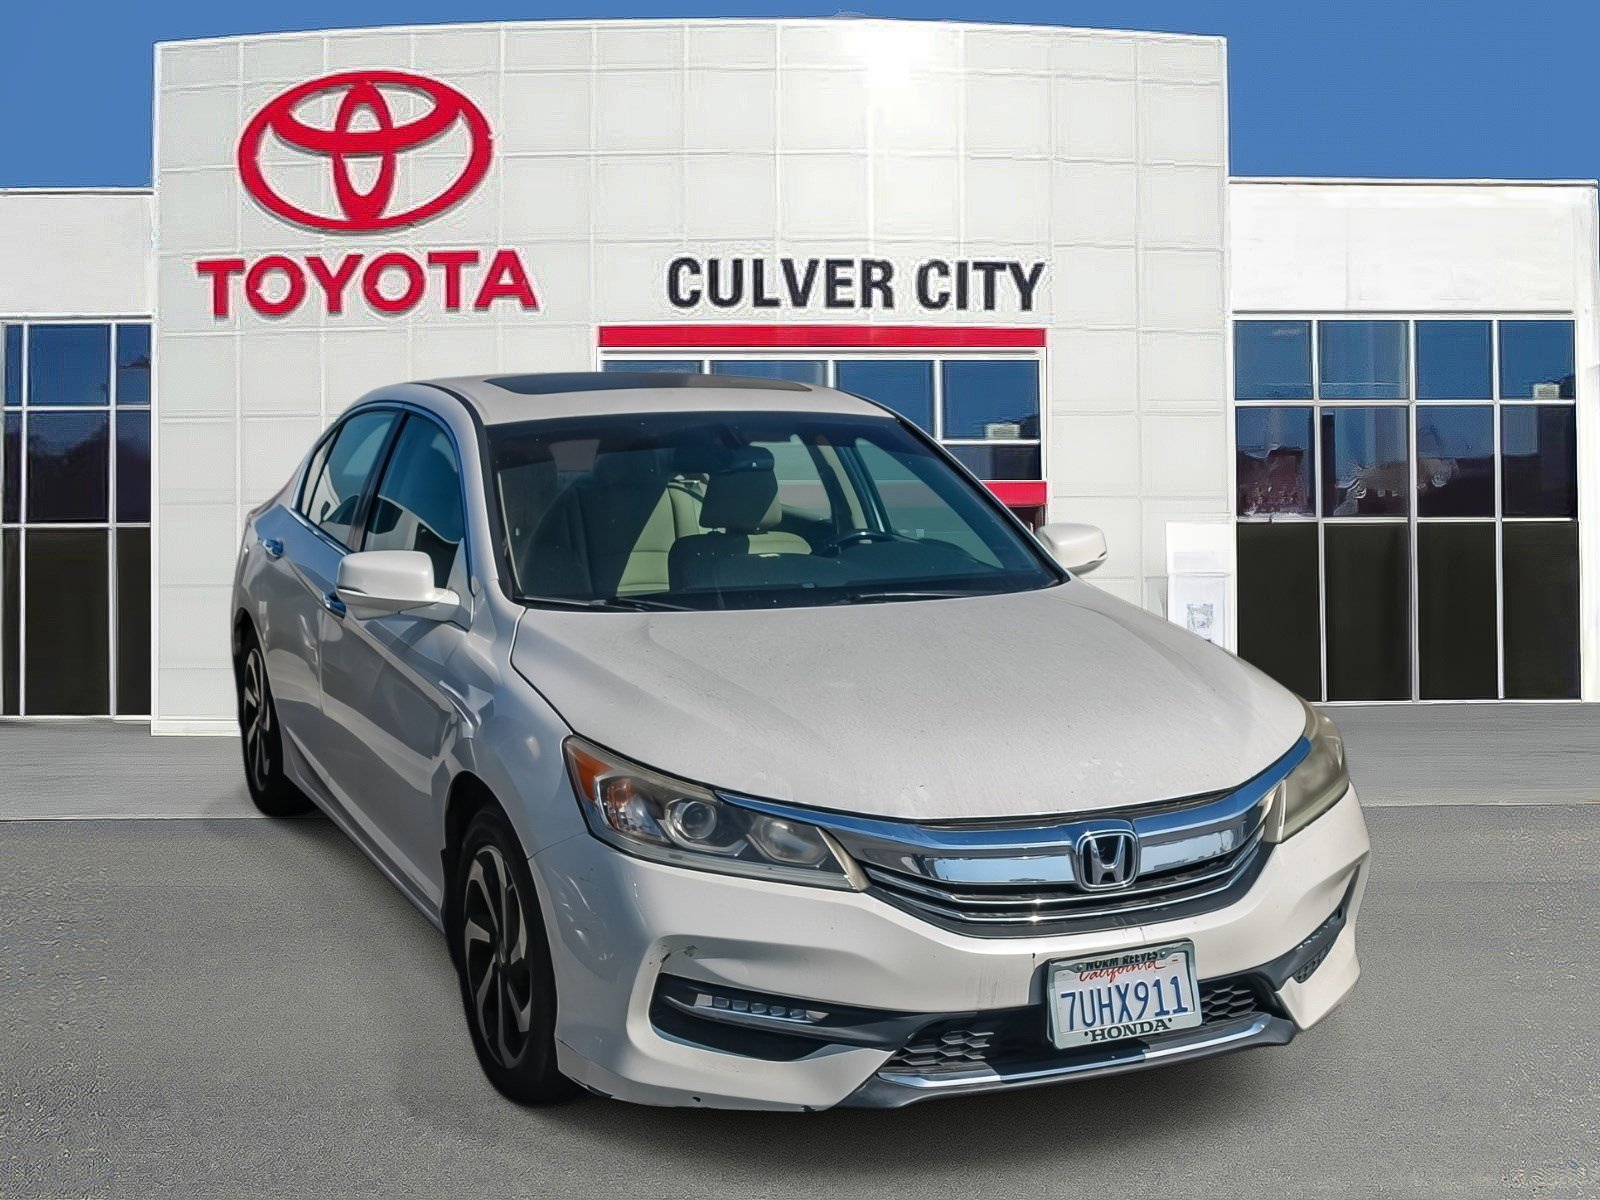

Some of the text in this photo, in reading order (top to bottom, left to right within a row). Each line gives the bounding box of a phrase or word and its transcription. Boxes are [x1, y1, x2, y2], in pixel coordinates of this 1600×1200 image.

[197, 249, 538, 319] TOYOTA
[667, 257, 1046, 311] CULVER CITY
[1061, 976, 1188, 1031] 7UHX911
[1090, 1019, 1171, 1042] HONDA
